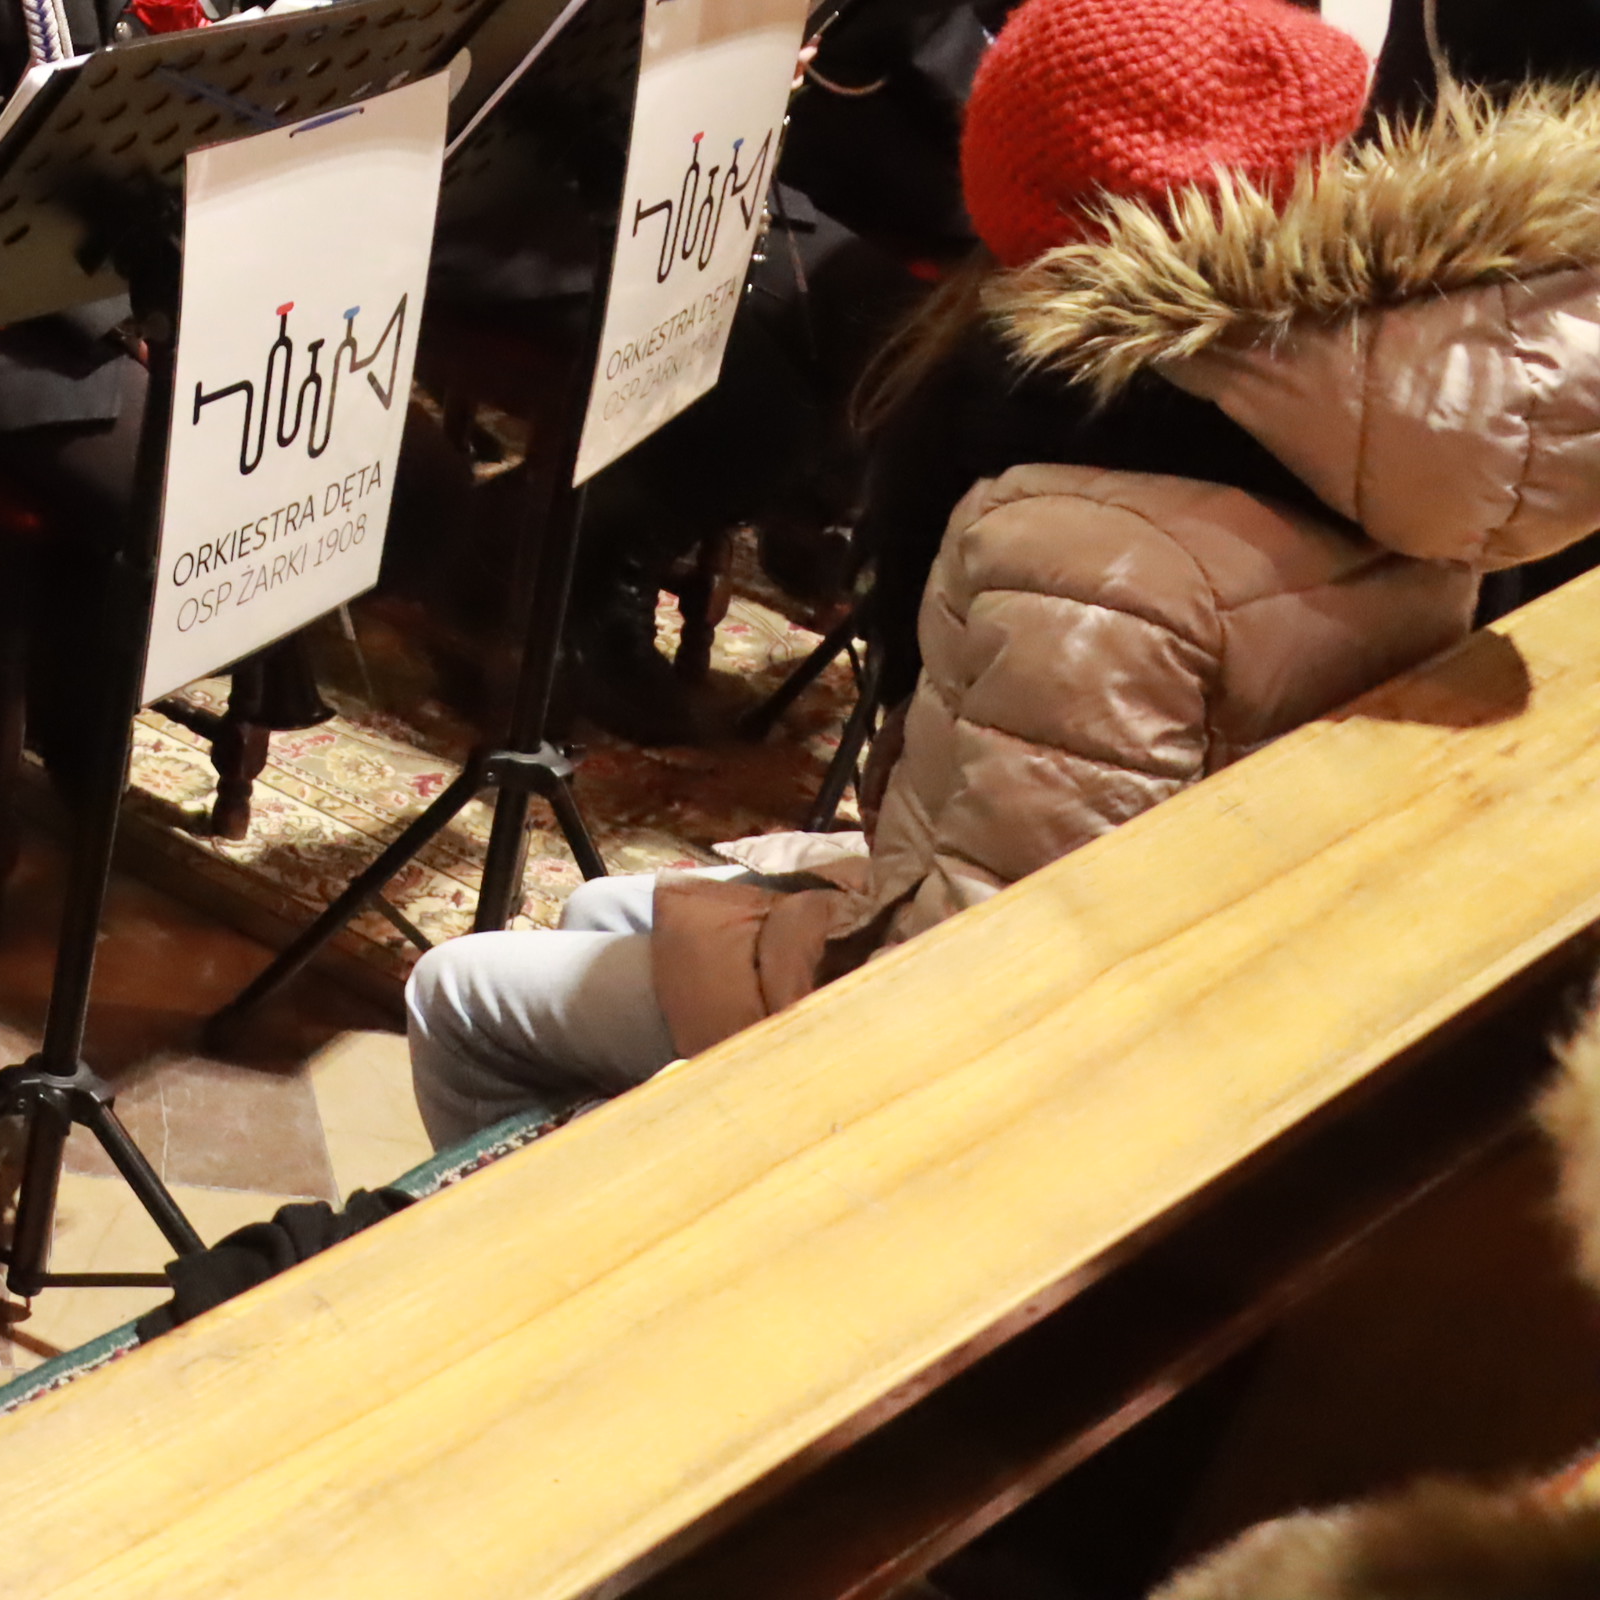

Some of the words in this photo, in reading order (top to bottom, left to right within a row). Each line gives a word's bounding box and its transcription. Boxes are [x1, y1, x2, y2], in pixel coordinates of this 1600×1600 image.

[606, 303, 697, 381] ORKIESTRA
[603, 377, 641, 422] OSP
[173, 494, 315, 587] ORKIESTRA
[323, 460, 382, 513] DĘTA
[176, 581, 232, 633] OSP
[236, 542, 308, 606] ŻARKI
[313, 513, 367, 568] 1908
